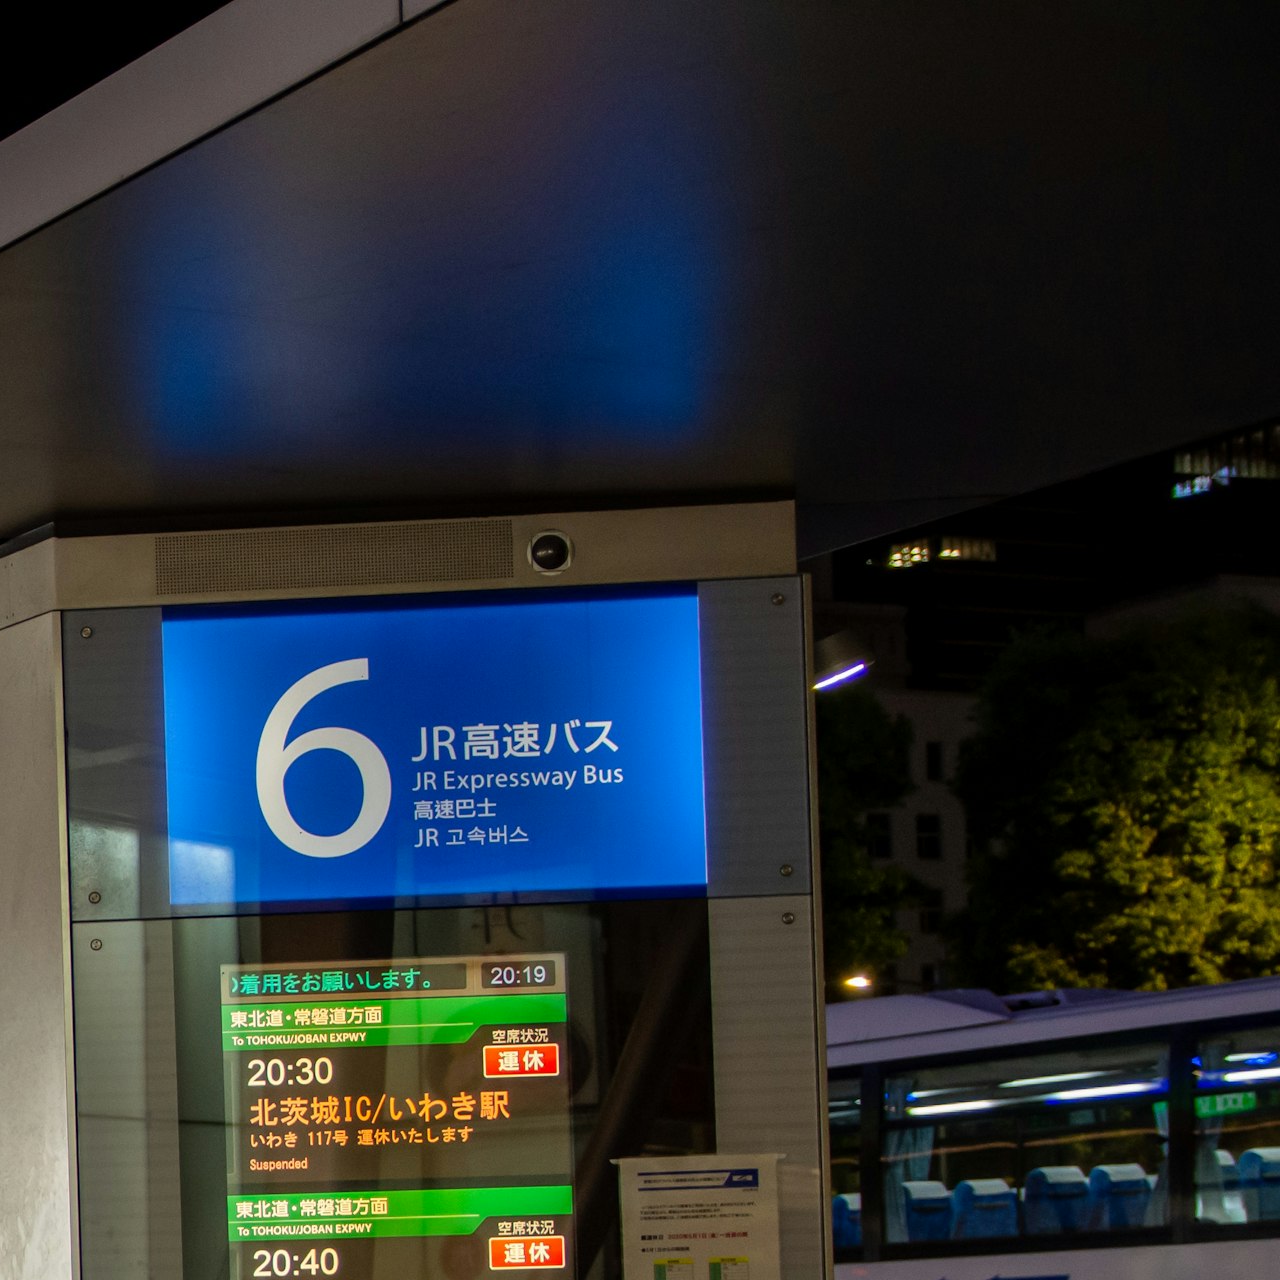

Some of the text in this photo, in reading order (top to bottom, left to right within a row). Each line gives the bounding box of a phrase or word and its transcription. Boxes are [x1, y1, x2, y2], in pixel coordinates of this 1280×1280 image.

[411, 719, 619, 763] JR高速バス
[256, 657, 391, 858] 6
[412, 765, 624, 794] JR Expressway Bus
[413, 797, 498, 821] 高速巴士
[414, 824, 530, 848] JR 고속버스
[490, 965, 547, 986] 20:19
[230, 1006, 383, 1030] 東北道・常磐道方面
[231, 1032, 368, 1046] To TOHOKU/JOBAN EXPWY
[491, 1028, 550, 1044] 空席状況
[247, 1057, 334, 1088] 20:30
[497, 1050, 545, 1073] 運休
[249, 1090, 511, 1127] 北茨城IC/いわき駅
[250, 1126, 474, 1149] いわき 117号 運休いたします
[249, 1157, 309, 1173] Suspended
[236, 1197, 389, 1219] 東北道・常磐道方面
[237, 1223, 373, 1237] To TOHOKU/JOBAN EXPWY
[497, 1220, 555, 1236] 空席状況
[252, 1247, 340, 1278] 20:40
[503, 1242, 551, 1265] 運休
